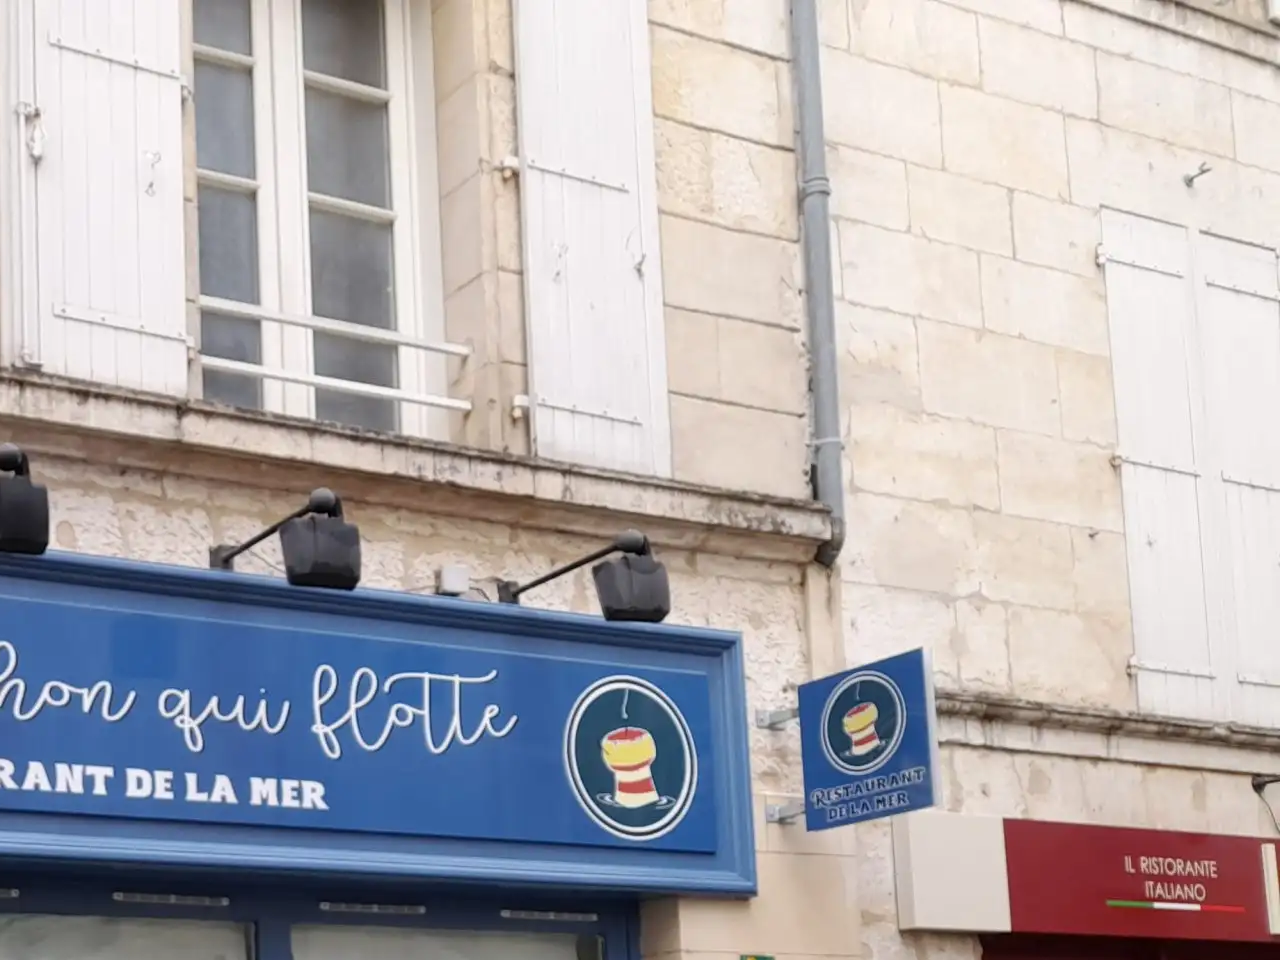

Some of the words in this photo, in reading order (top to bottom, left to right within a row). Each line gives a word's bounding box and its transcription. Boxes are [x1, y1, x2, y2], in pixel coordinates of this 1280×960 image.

[157, 687, 291, 753] qui
[124, 766, 175, 800] DE
[184, 771, 239, 804] LA
[249, 776, 330, 811] MER
[810, 766, 926, 809] RESTAURANT
[827, 806, 847, 823] DE
[850, 799, 872, 817] LA
[874, 791, 910, 811] MER
[1124, 855, 1136, 874] IL
[1140, 855, 1219, 879] RISTORANTE
[1144, 880, 1206, 902] ITALIANO
